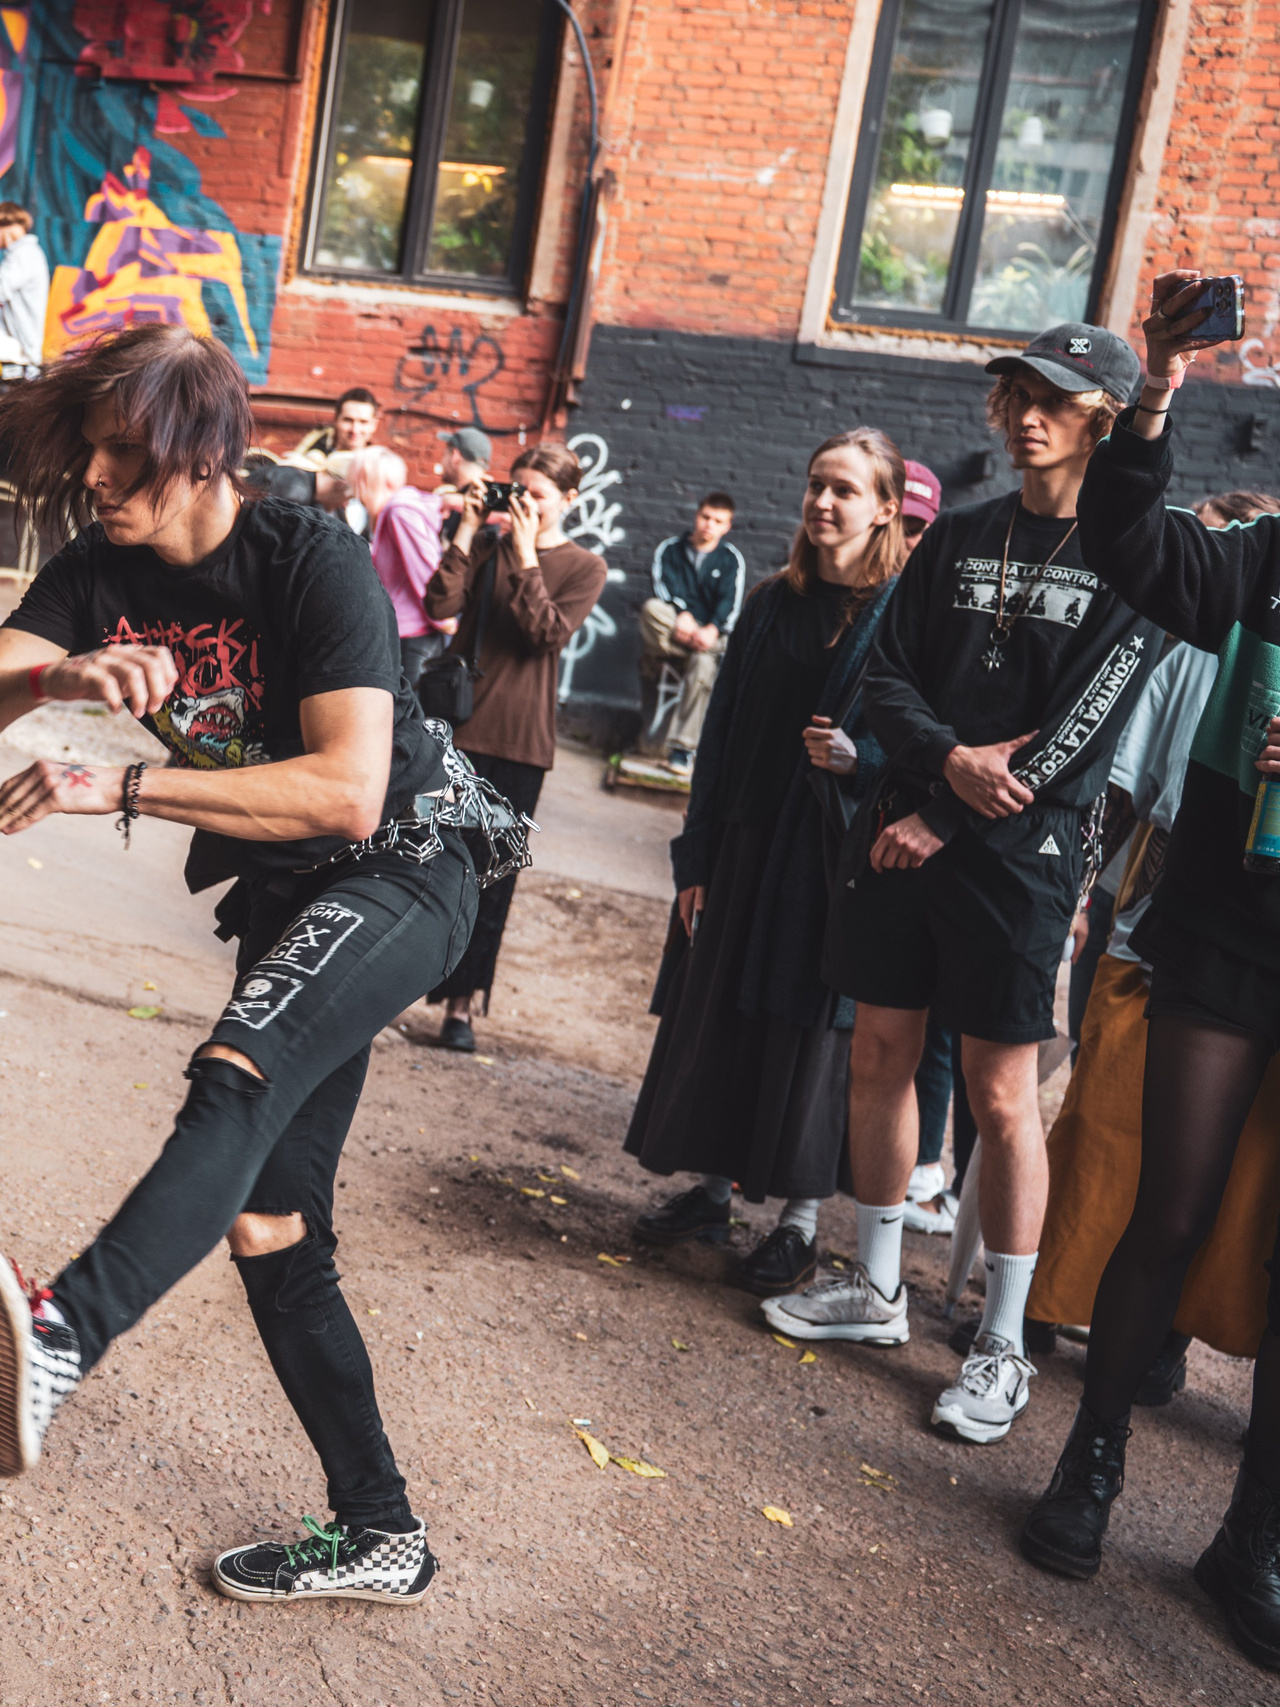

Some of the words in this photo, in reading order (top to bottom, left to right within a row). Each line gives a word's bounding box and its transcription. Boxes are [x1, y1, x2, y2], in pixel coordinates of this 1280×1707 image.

[1042, 568, 1099, 589] CONTRA
[1083, 650, 1136, 722] CONTRA
[1064, 722, 1091, 749] LA
